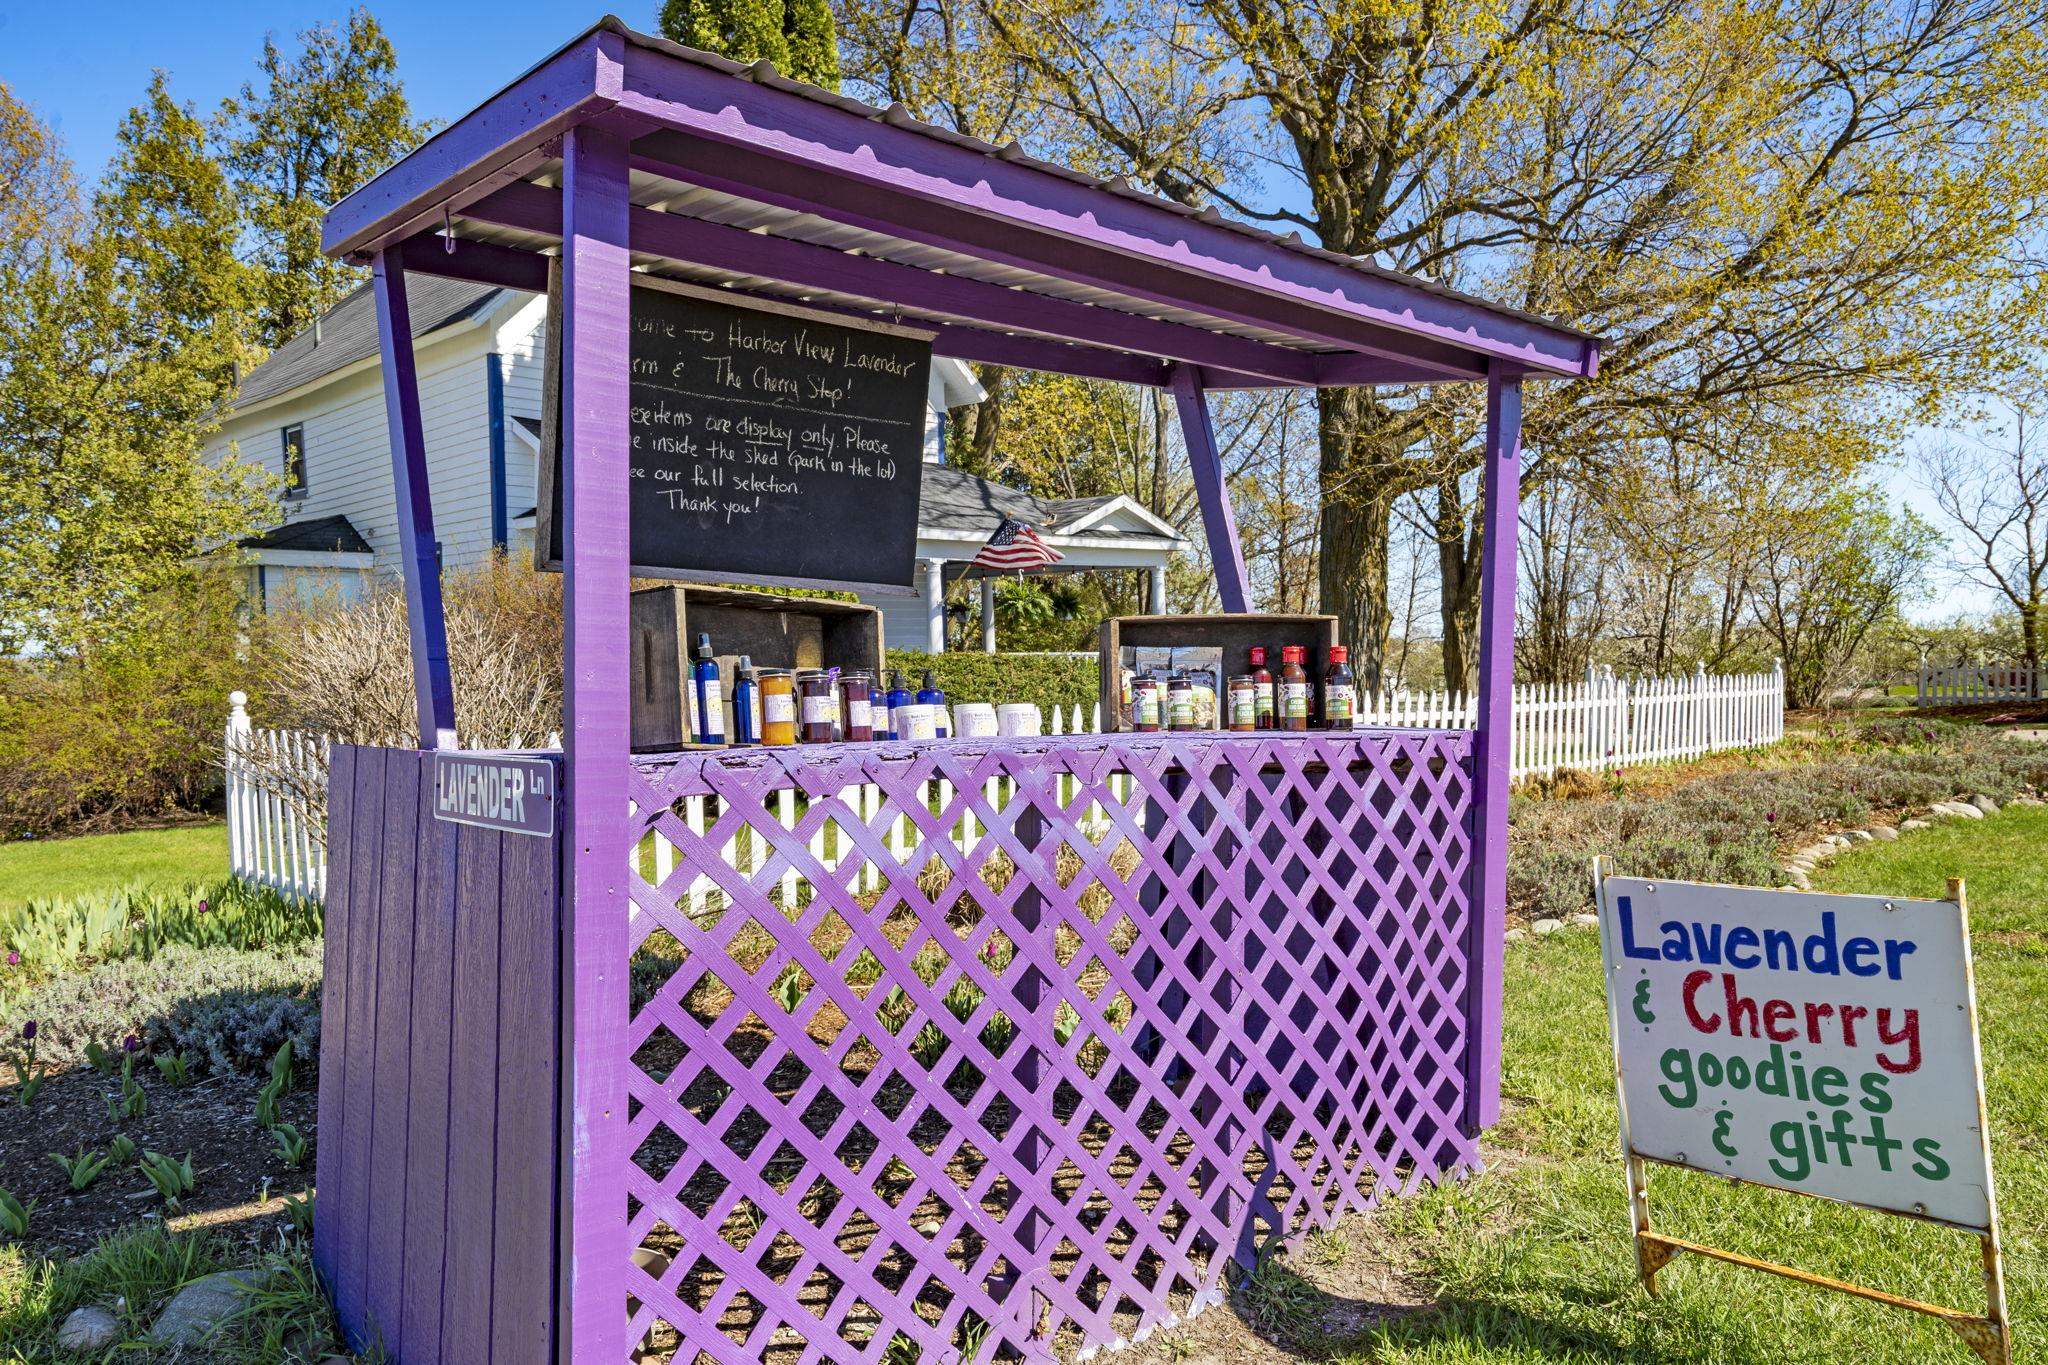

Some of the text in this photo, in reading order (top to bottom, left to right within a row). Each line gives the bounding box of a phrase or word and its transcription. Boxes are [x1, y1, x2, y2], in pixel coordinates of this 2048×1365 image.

[684, 319, 715, 342] to
[728, 317, 788, 355] Harbor
[794, 328, 835, 364] View
[843, 336, 916, 379] Lavender
[700, 354, 743, 389] The
[752, 365, 800, 402] Cherry
[806, 374, 852, 409] Stop!
[648, 432, 699, 458] inside
[705, 439, 736, 462] the
[787, 449, 826, 475] (park
[830, 456, 844, 473] in
[847, 456, 873, 478] the
[876, 458, 897, 481] lot)
[652, 399, 693, 428] items
[704, 415, 732, 434] are
[735, 415, 793, 451] display
[800, 422, 841, 458] only.
[843, 424, 892, 455] Please
[653, 468, 682, 482] our
[691, 463, 723, 487] full
[732, 472, 804, 495] selection.
[655, 487, 760, 525] Thank you!
[439, 761, 545, 823] LAVENDER Ln
[1616, 895, 1918, 981] Lavender
[1632, 967, 1922, 1075] & Cherry
[1657, 1043, 1894, 1115] goodies
[1711, 1099, 1952, 1182] & gifts
